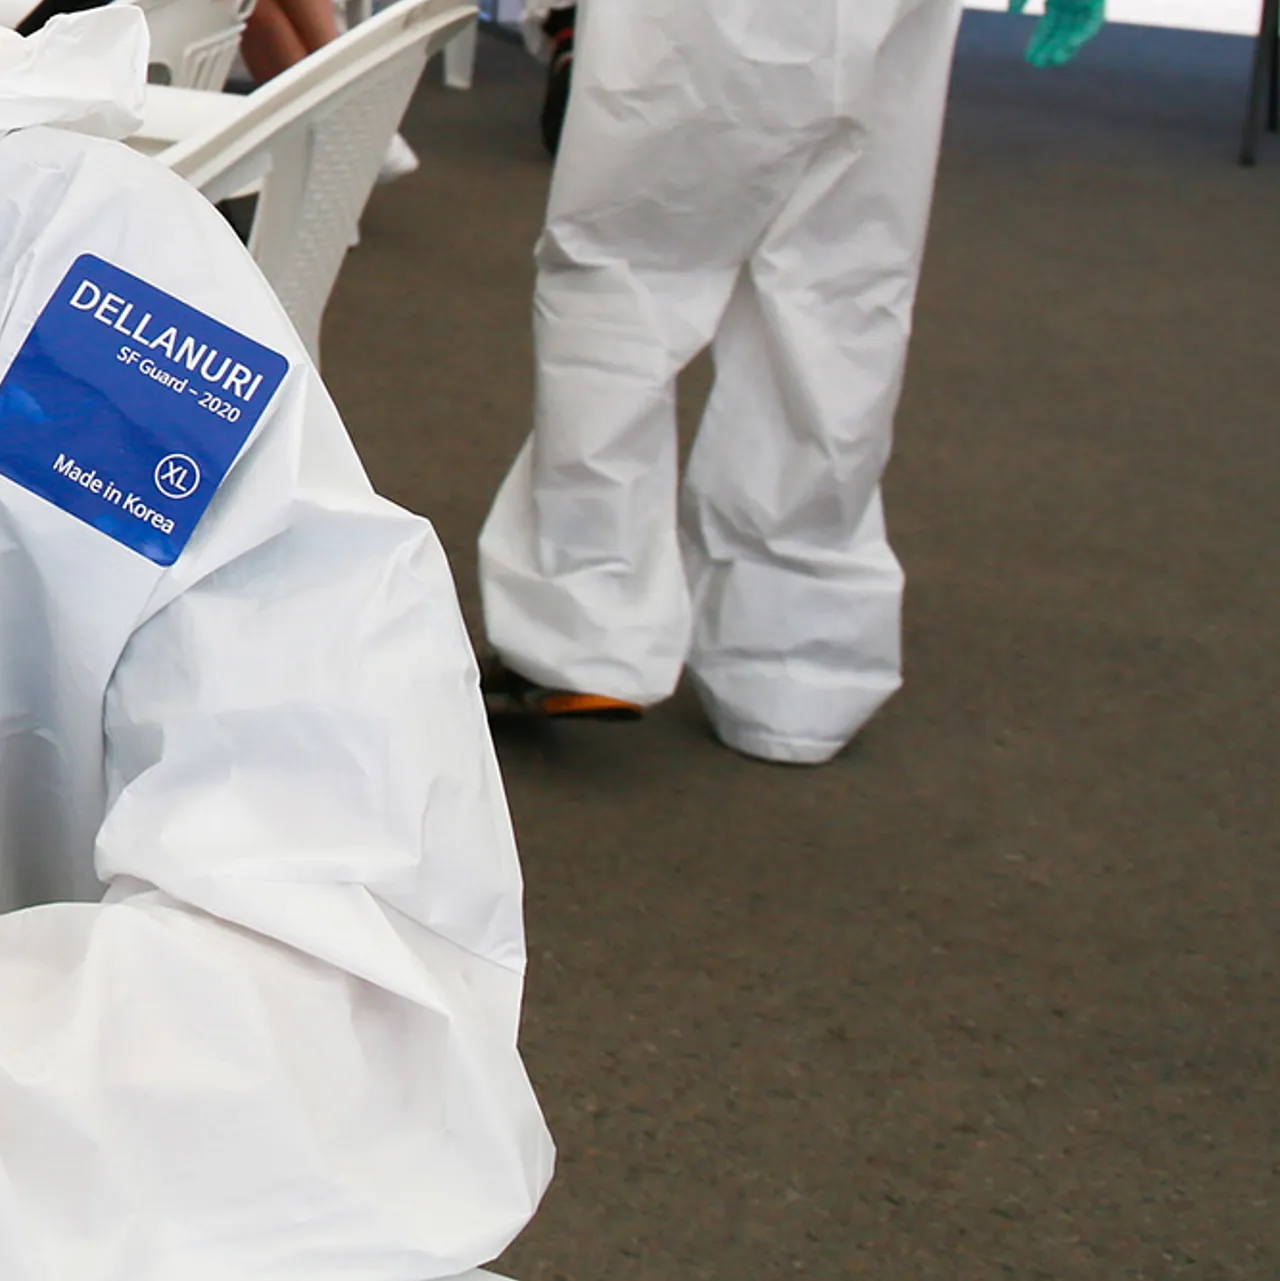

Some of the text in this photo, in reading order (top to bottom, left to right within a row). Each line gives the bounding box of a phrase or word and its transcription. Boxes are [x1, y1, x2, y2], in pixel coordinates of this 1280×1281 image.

[69, 279, 263, 402] DELLANURI
[116, 346, 140, 365] SF
[139, 359, 185, 395] Guard
[198, 392, 241, 424] 2020
[52, 453, 176, 536] Made in Korea
[159, 460, 190, 493] XL
